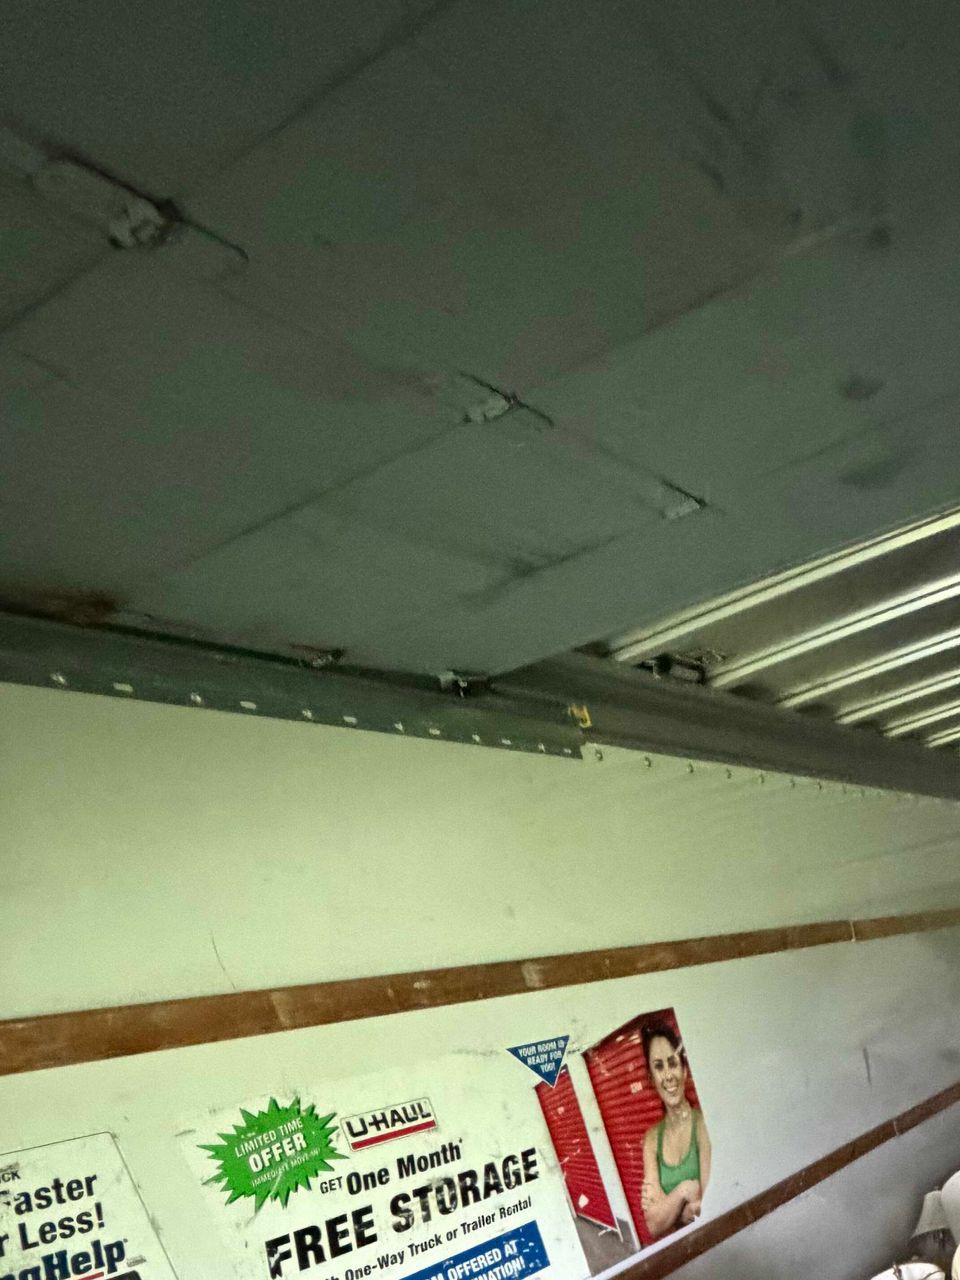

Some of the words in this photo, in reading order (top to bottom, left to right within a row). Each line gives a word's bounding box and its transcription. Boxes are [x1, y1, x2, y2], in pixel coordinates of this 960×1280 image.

[518, 1044, 536, 1057] YOUR
[235, 1130, 277, 1158] LIMITED
[279, 1119, 303, 1138] TIME
[346, 1102, 432, 1138] U-HAUL
[249, 1132, 308, 1173] OFFER
[320, 1176, 343, 1195] GET
[346, 1164, 390, 1195] One
[18, 1202, 105, 1250] Less!
[265, 1204, 378, 1280] FREE
[390, 1147, 539, 1233] STORAGE
[408, 1233, 442, 1257] Truck
[446, 1226, 458, 1242] or
[460, 1212, 496, 1237] Trailer
[500, 1195, 532, 1219] Rental
[504, 1239, 519, 1257] AT
